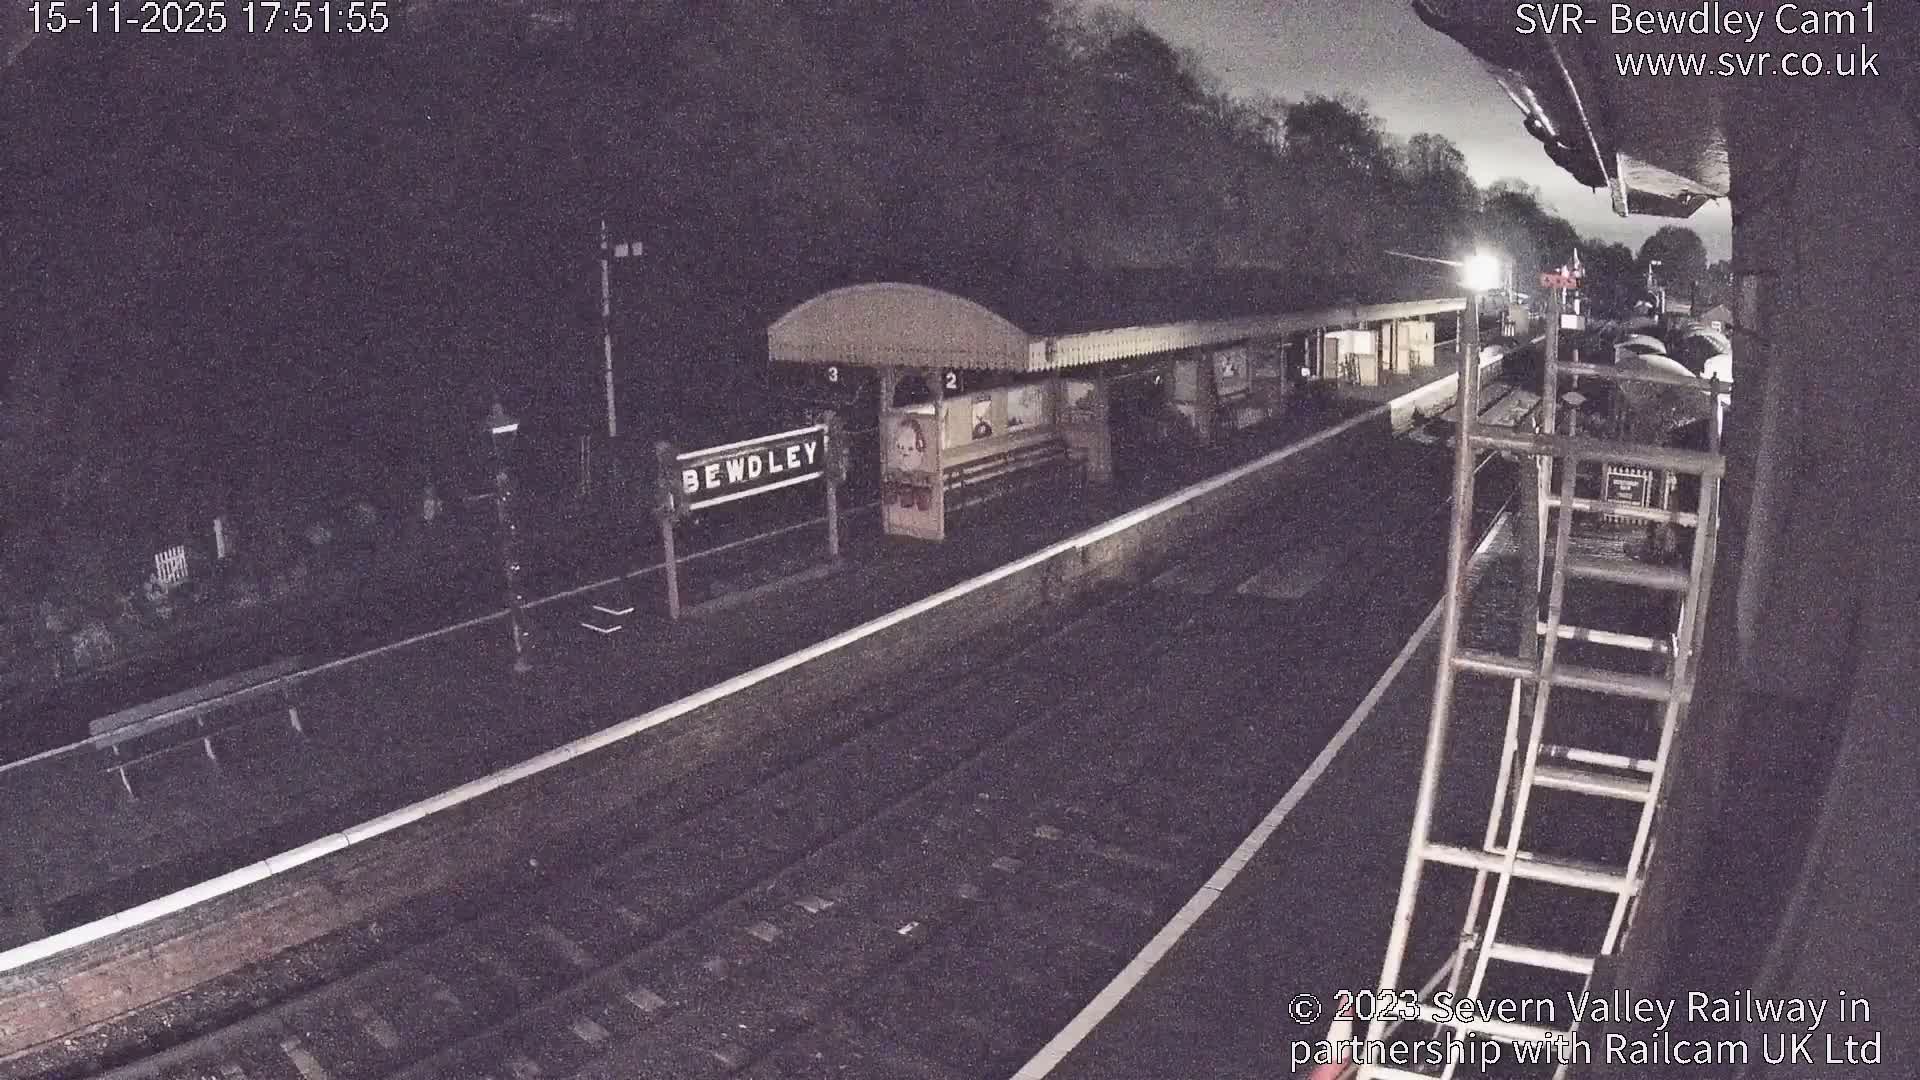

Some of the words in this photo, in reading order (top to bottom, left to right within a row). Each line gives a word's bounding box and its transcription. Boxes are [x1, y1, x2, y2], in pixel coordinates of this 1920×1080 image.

[828, 366, 839, 382] 3
[945, 372, 957, 389] 2
[682, 441, 817, 494] BEWDLEY
